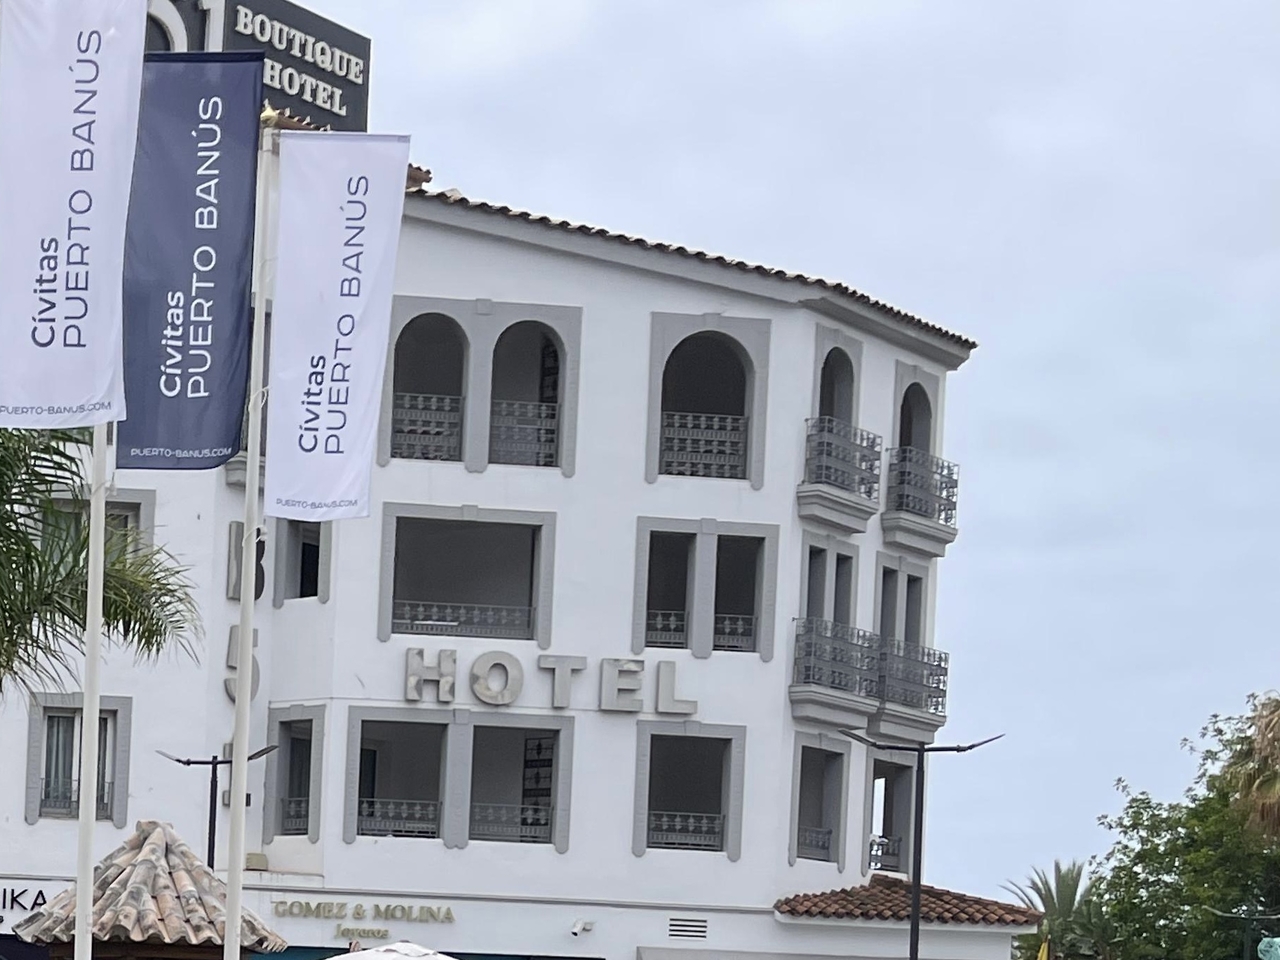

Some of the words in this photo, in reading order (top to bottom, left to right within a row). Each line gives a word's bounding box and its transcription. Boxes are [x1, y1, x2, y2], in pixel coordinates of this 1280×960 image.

[234, 4, 364, 85] BOUTIQUE
[262, 57, 347, 117] HOTEL
[68, 29, 102, 171] BANÚS
[191, 96, 223, 229] BANÚS
[63, 189, 93, 348] PUERTO
[339, 175, 369, 297] BANÚS
[31, 237, 59, 348] Cívitas
[159, 290, 185, 398] Cívitas
[186, 245, 217, 398] PUERTO
[0, 401, 112, 415] PUERTO-BANUS.COM
[298, 355, 326, 453] Cívitas
[324, 313, 355, 454] PUERTO
[130, 447, 232, 458] PUERTO-BANUS.COM
[405, 647, 699, 714] HOTEL
[273, 900, 348, 920] GOMEZ
[372, 903, 457, 923] MOLINA
